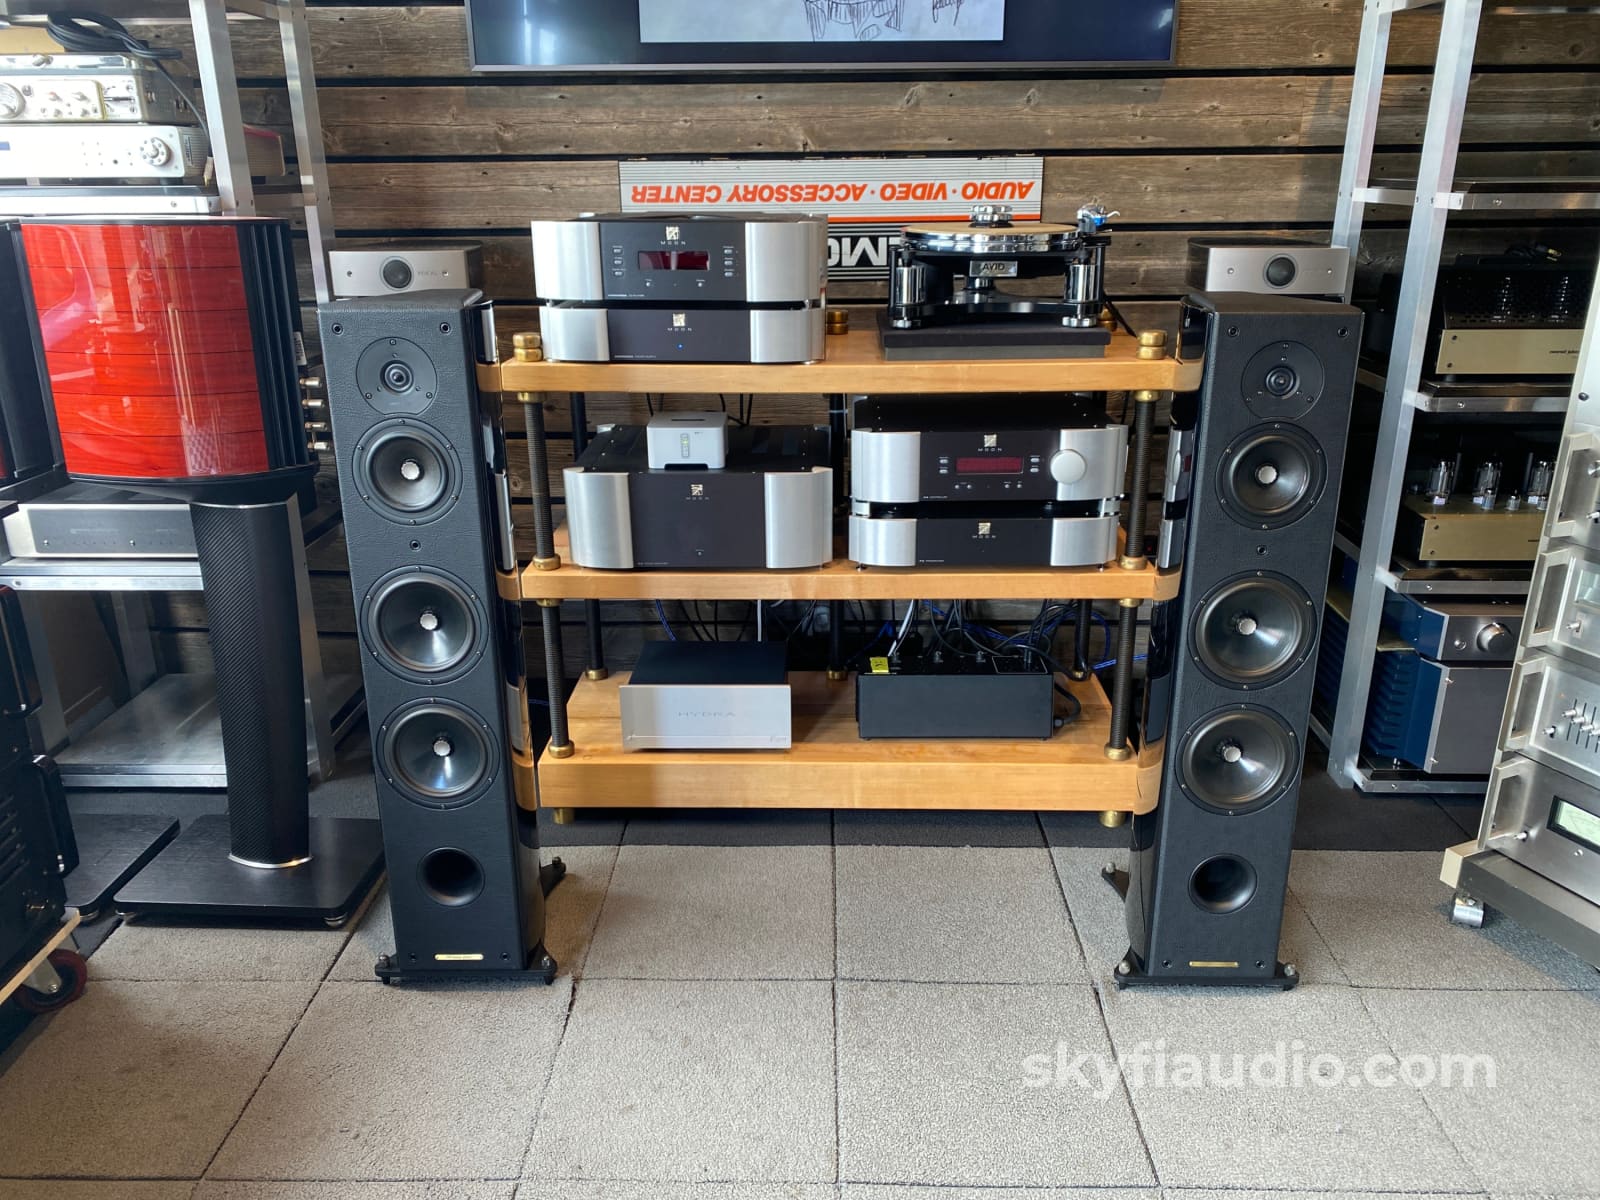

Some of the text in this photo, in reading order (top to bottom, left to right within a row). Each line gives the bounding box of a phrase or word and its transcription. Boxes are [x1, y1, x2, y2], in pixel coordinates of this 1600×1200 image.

[631, 181, 1034, 203] AUDIO VIDEO ACCESSORY CENTER
[982, 263, 1005, 271] AVID
